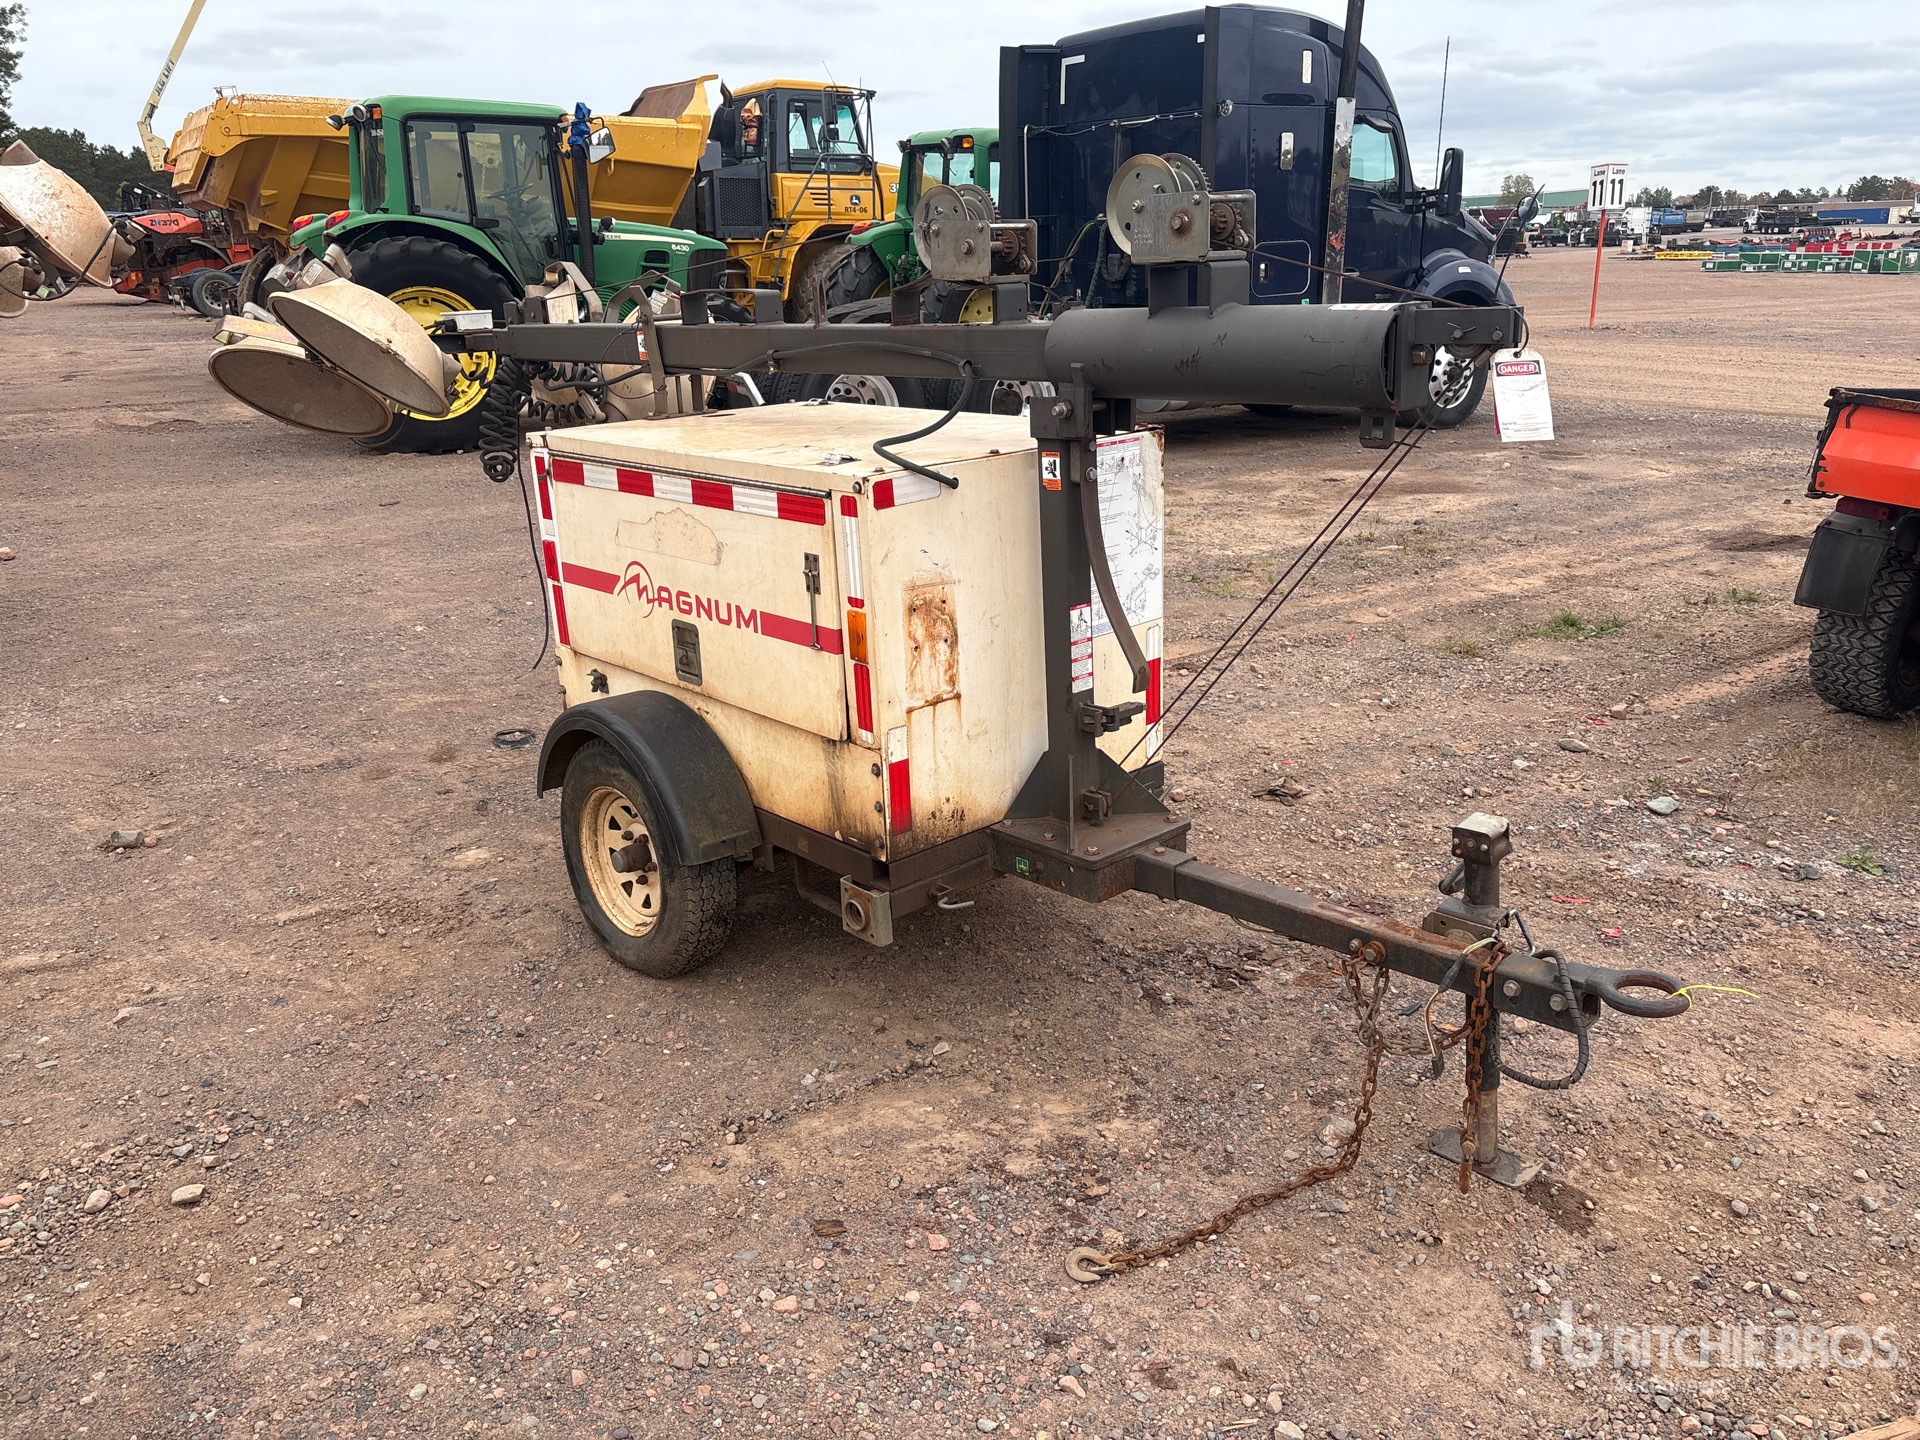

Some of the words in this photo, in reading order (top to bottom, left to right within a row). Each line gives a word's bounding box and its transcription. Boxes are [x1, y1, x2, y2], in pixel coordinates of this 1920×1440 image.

[154, 78, 166, 97] JLG
[162, 57, 175, 79] LIFT
[1593, 169, 1606, 177] Lane
[1612, 167, 1626, 175] Lane
[1592, 179, 1604, 207] 11
[1610, 178, 1624, 205] 11
[844, 206, 868, 214] RT4-06
[671, 243, 690, 252] 6430
[1501, 364, 1535, 373] DANGER
[617, 561, 758, 634] MAGNUM
